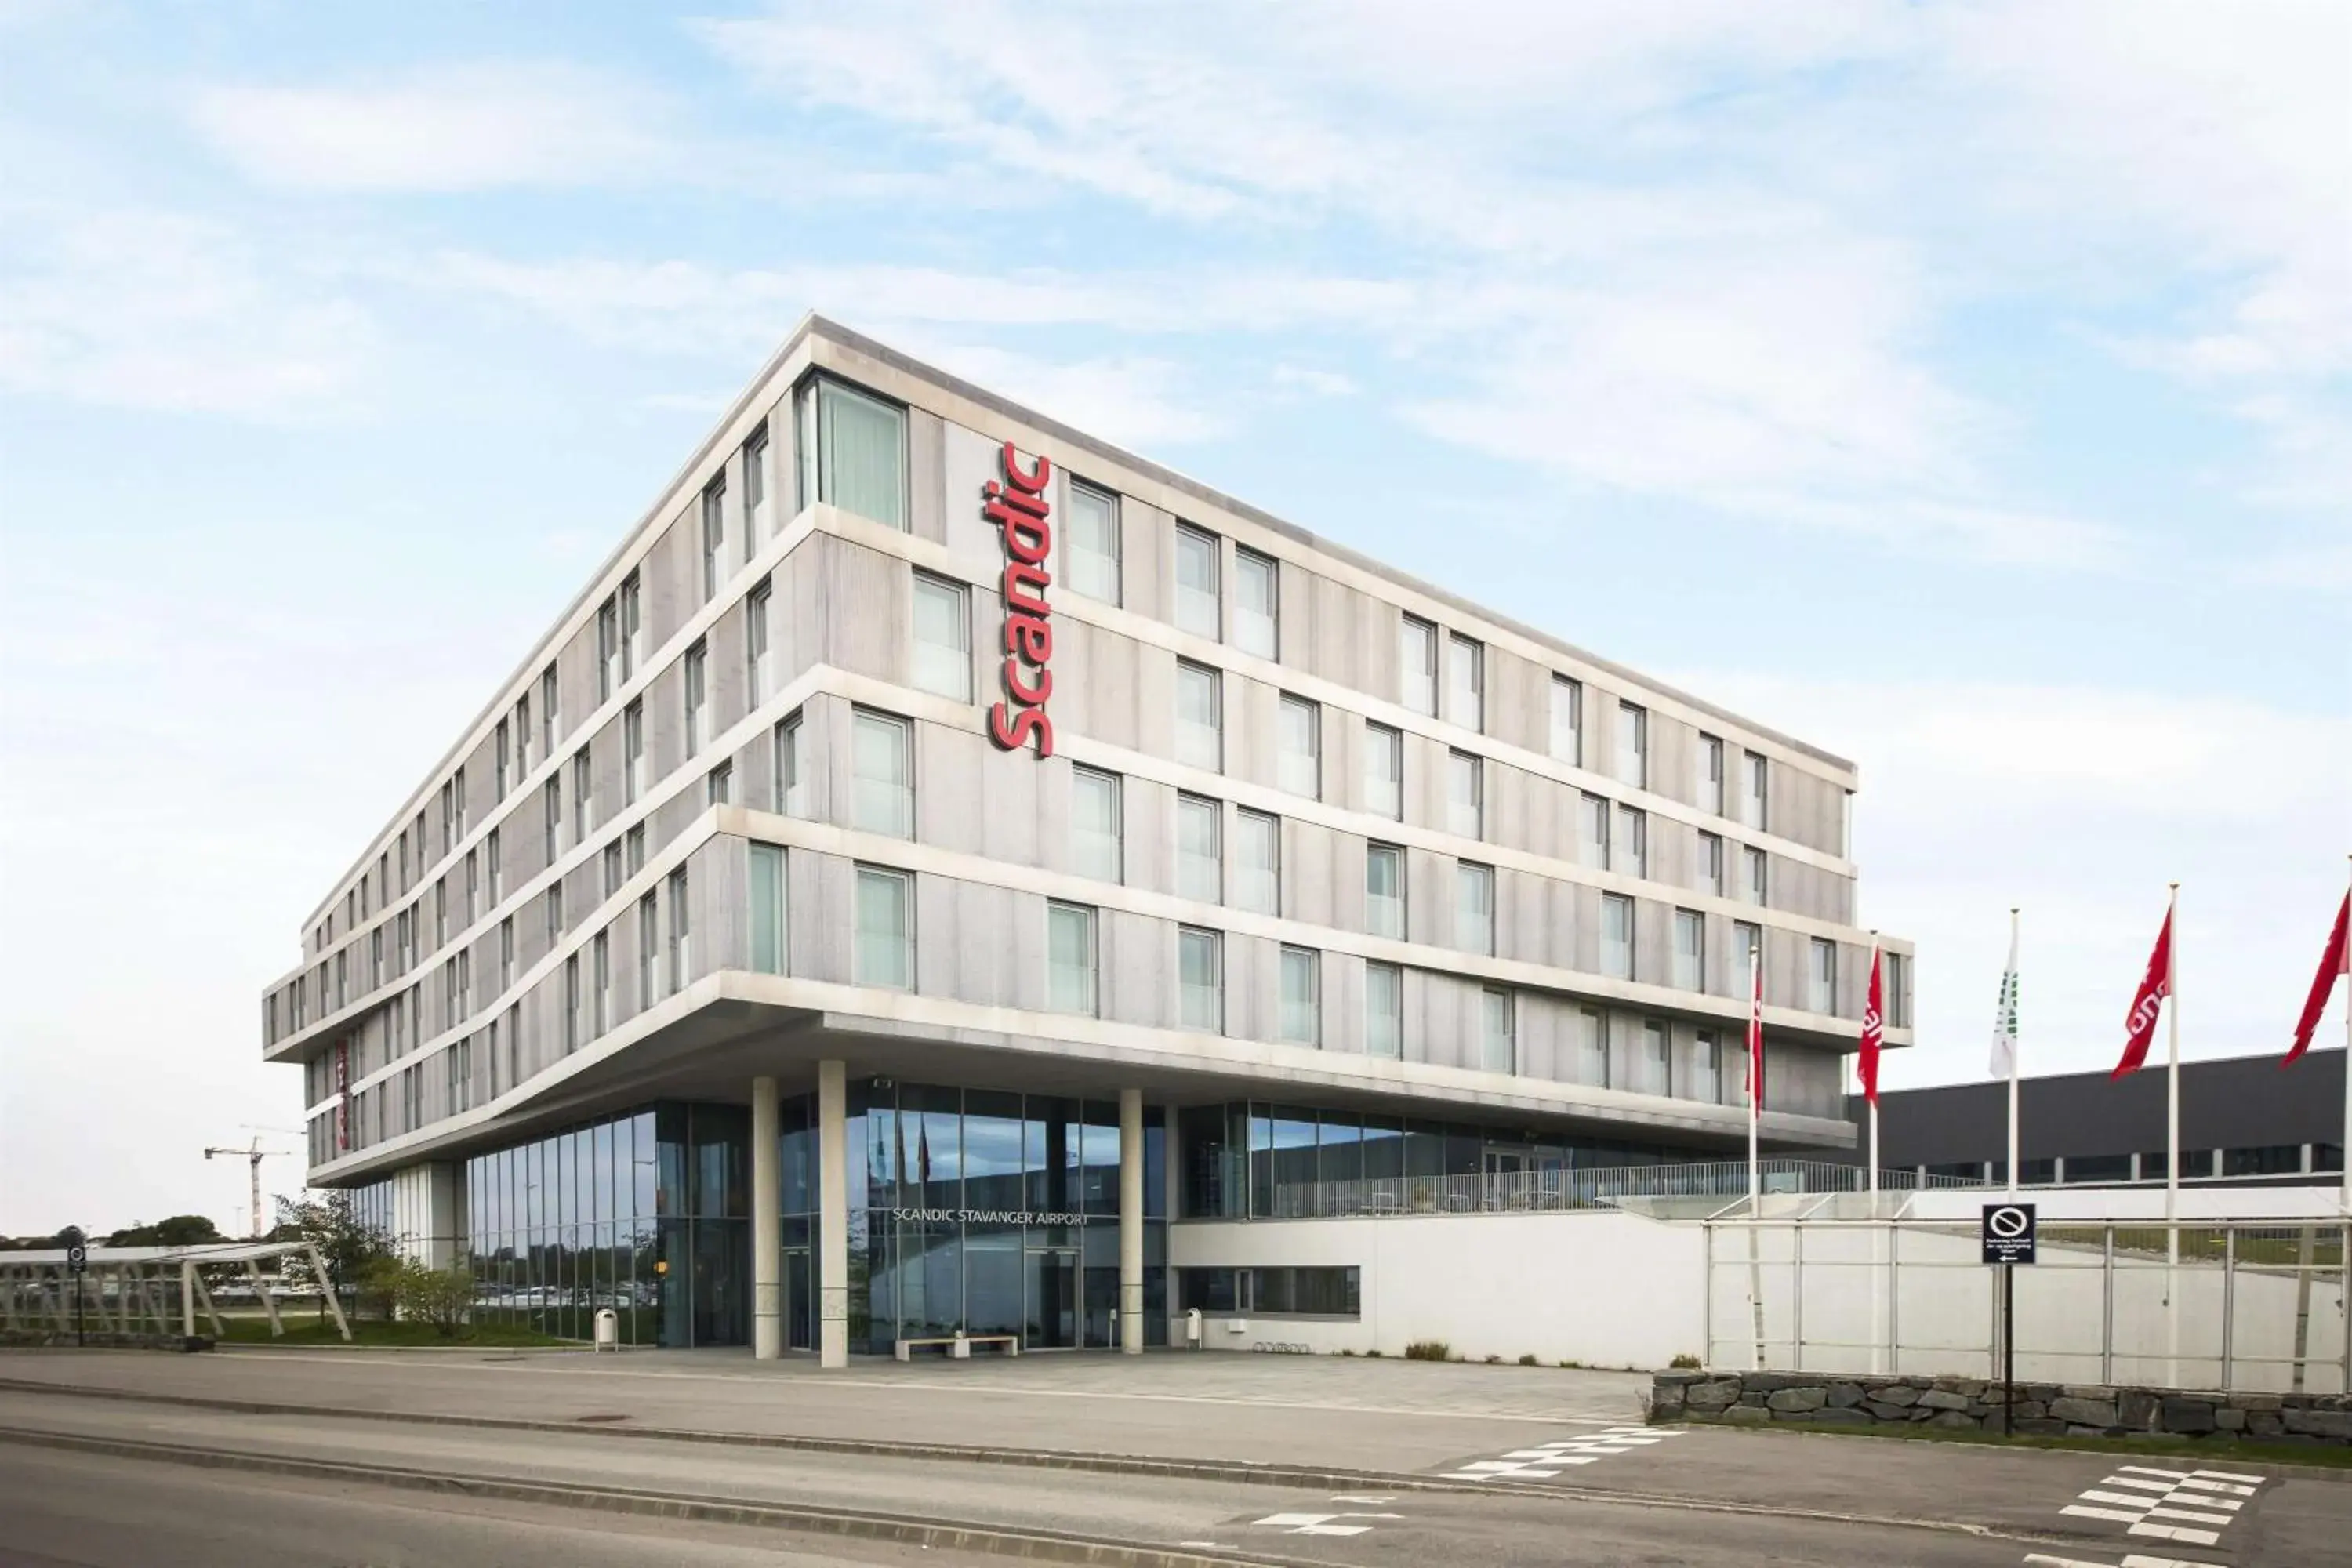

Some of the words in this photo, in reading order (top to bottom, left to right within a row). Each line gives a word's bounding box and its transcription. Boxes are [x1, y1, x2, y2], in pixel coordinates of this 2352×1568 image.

[892, 1207, 955, 1222] SCANDIC
[958, 1210, 1033, 1224] STAVANGER
[1036, 1212, 1089, 1225] AIRPORT
